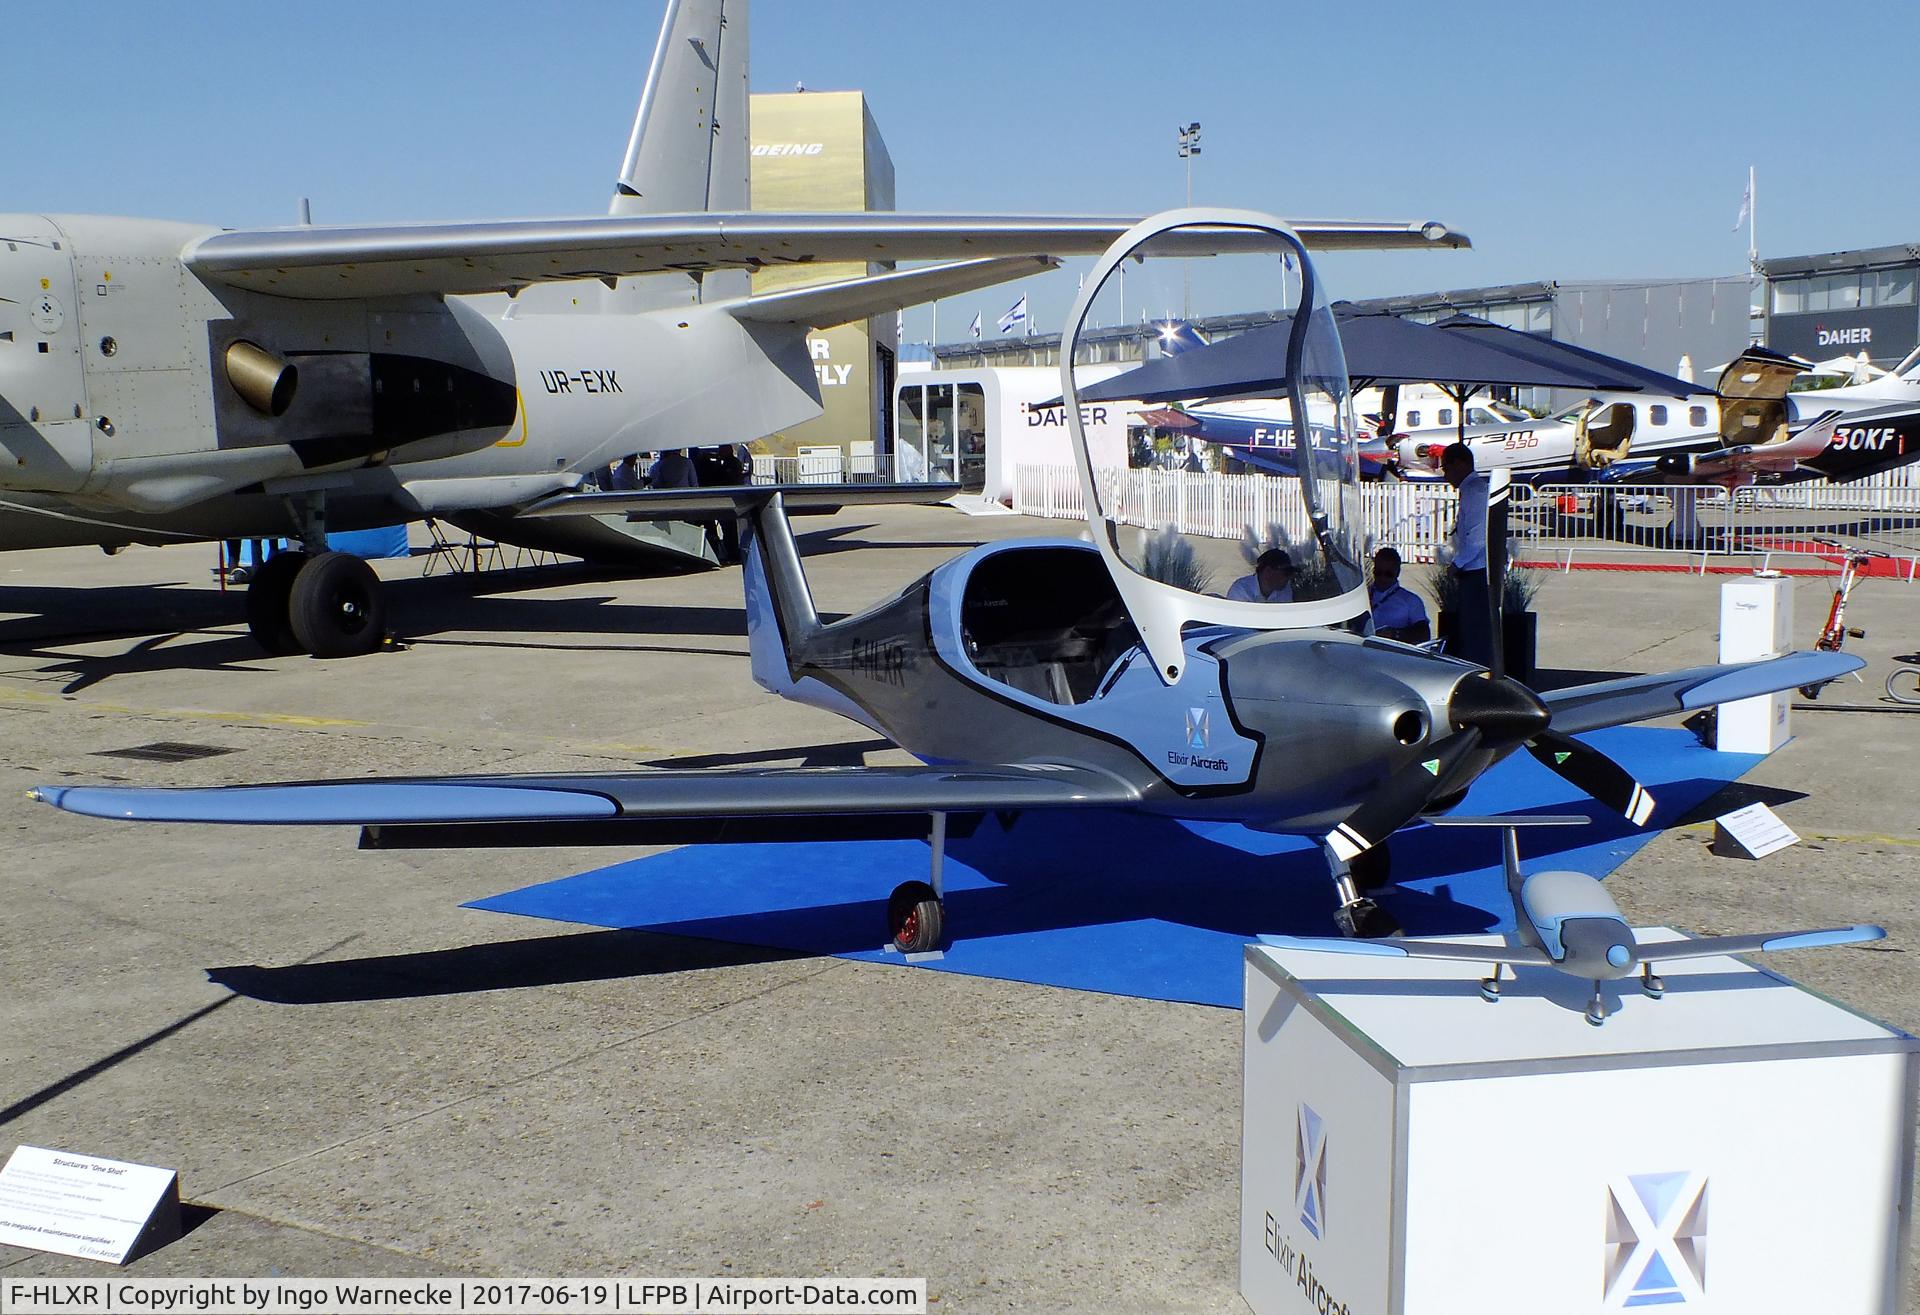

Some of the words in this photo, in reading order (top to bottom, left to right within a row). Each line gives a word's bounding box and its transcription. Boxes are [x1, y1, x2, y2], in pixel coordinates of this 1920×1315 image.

[750, 144, 823, 156] OEING
[1818, 327, 1872, 346] DAHER
[540, 370, 624, 394] UR-EXK
[1504, 438, 1539, 451] 930
[1168, 751, 1189, 765] Elixir
[1190, 754, 1229, 771] Aircraft
[53, 1158, 89, 1170] Structures
[1265, 1210, 1295, 1277] Elixir
